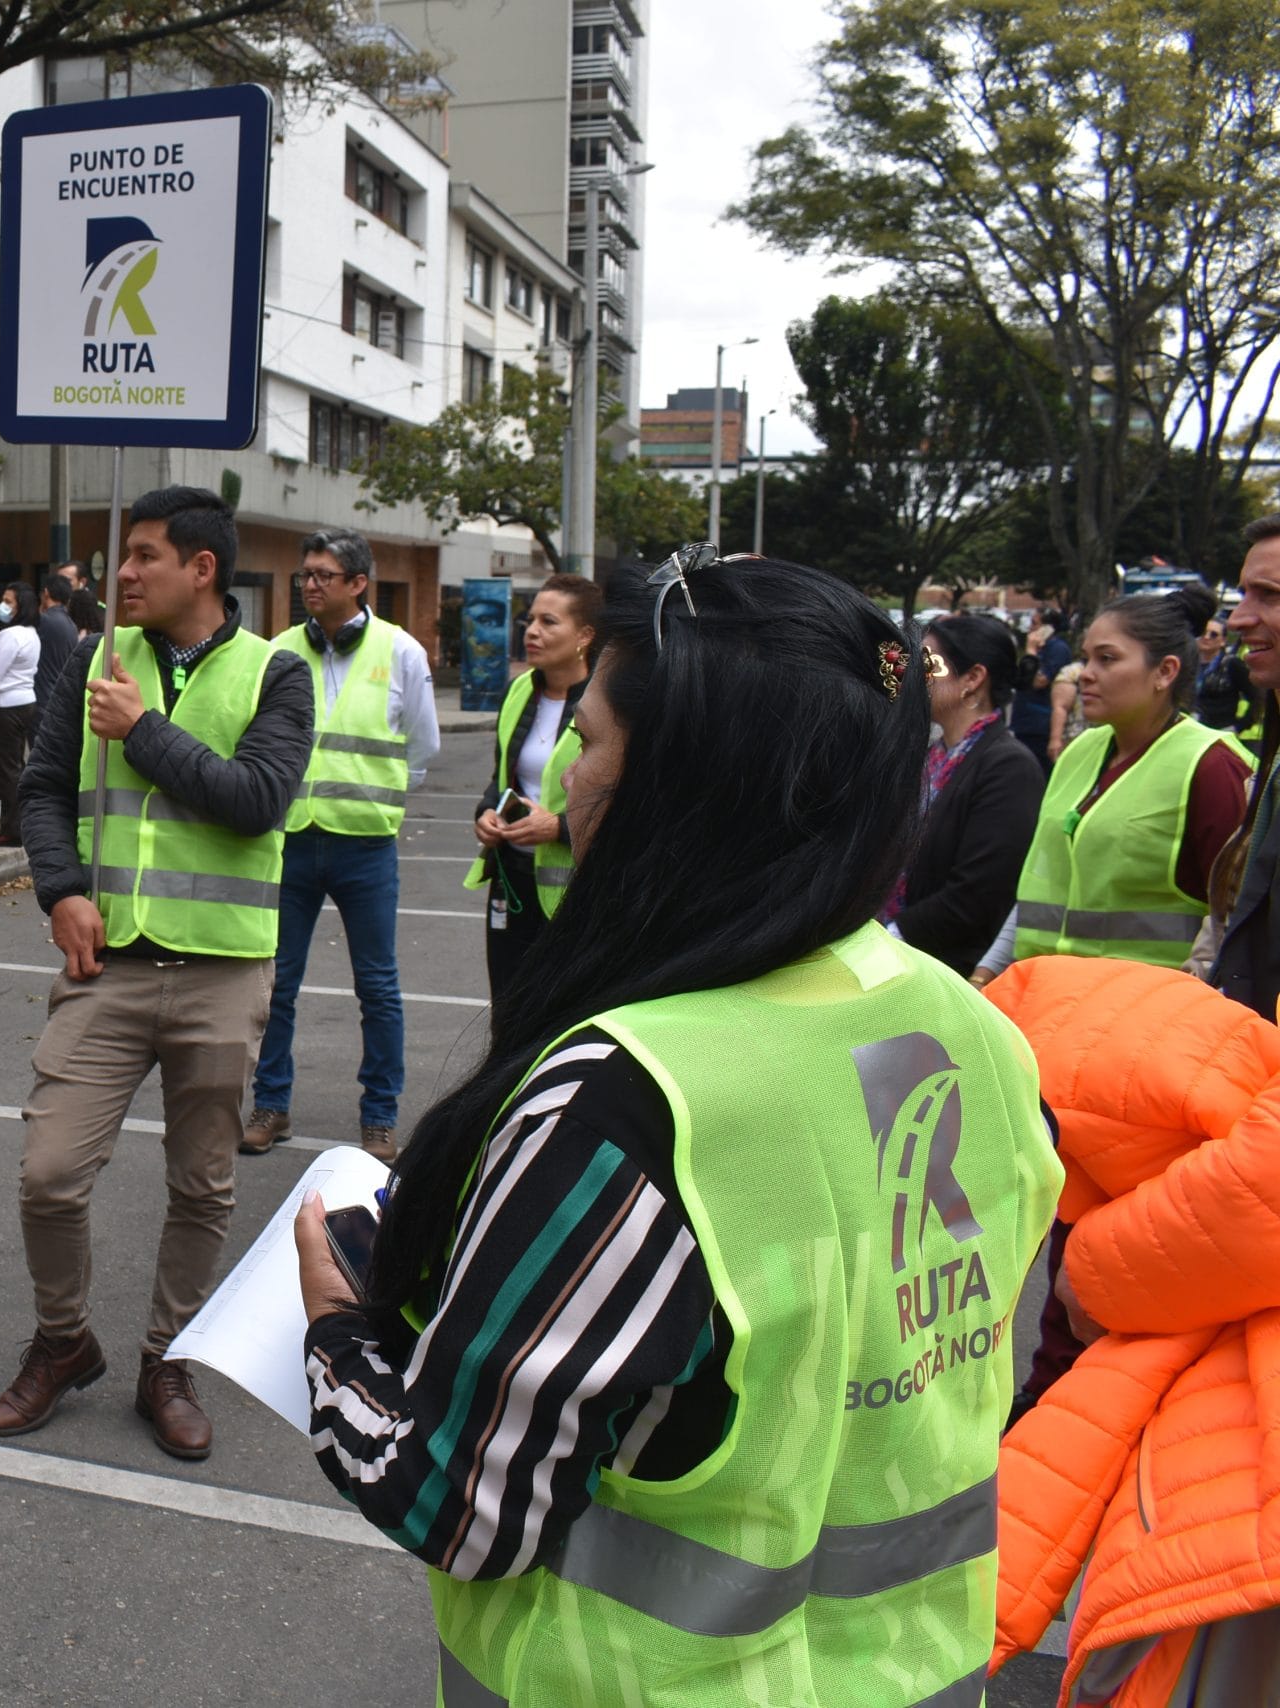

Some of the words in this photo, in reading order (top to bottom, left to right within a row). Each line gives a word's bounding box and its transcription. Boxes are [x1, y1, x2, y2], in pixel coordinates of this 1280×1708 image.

[70, 147, 145, 173] PUNTO
[154, 143, 184, 165] DE
[58, 171, 195, 200] ENCUENTRO
[82, 342, 156, 374] RUTA
[127, 386, 186, 405] NORTE
[895, 1251, 991, 1344] RUTA
